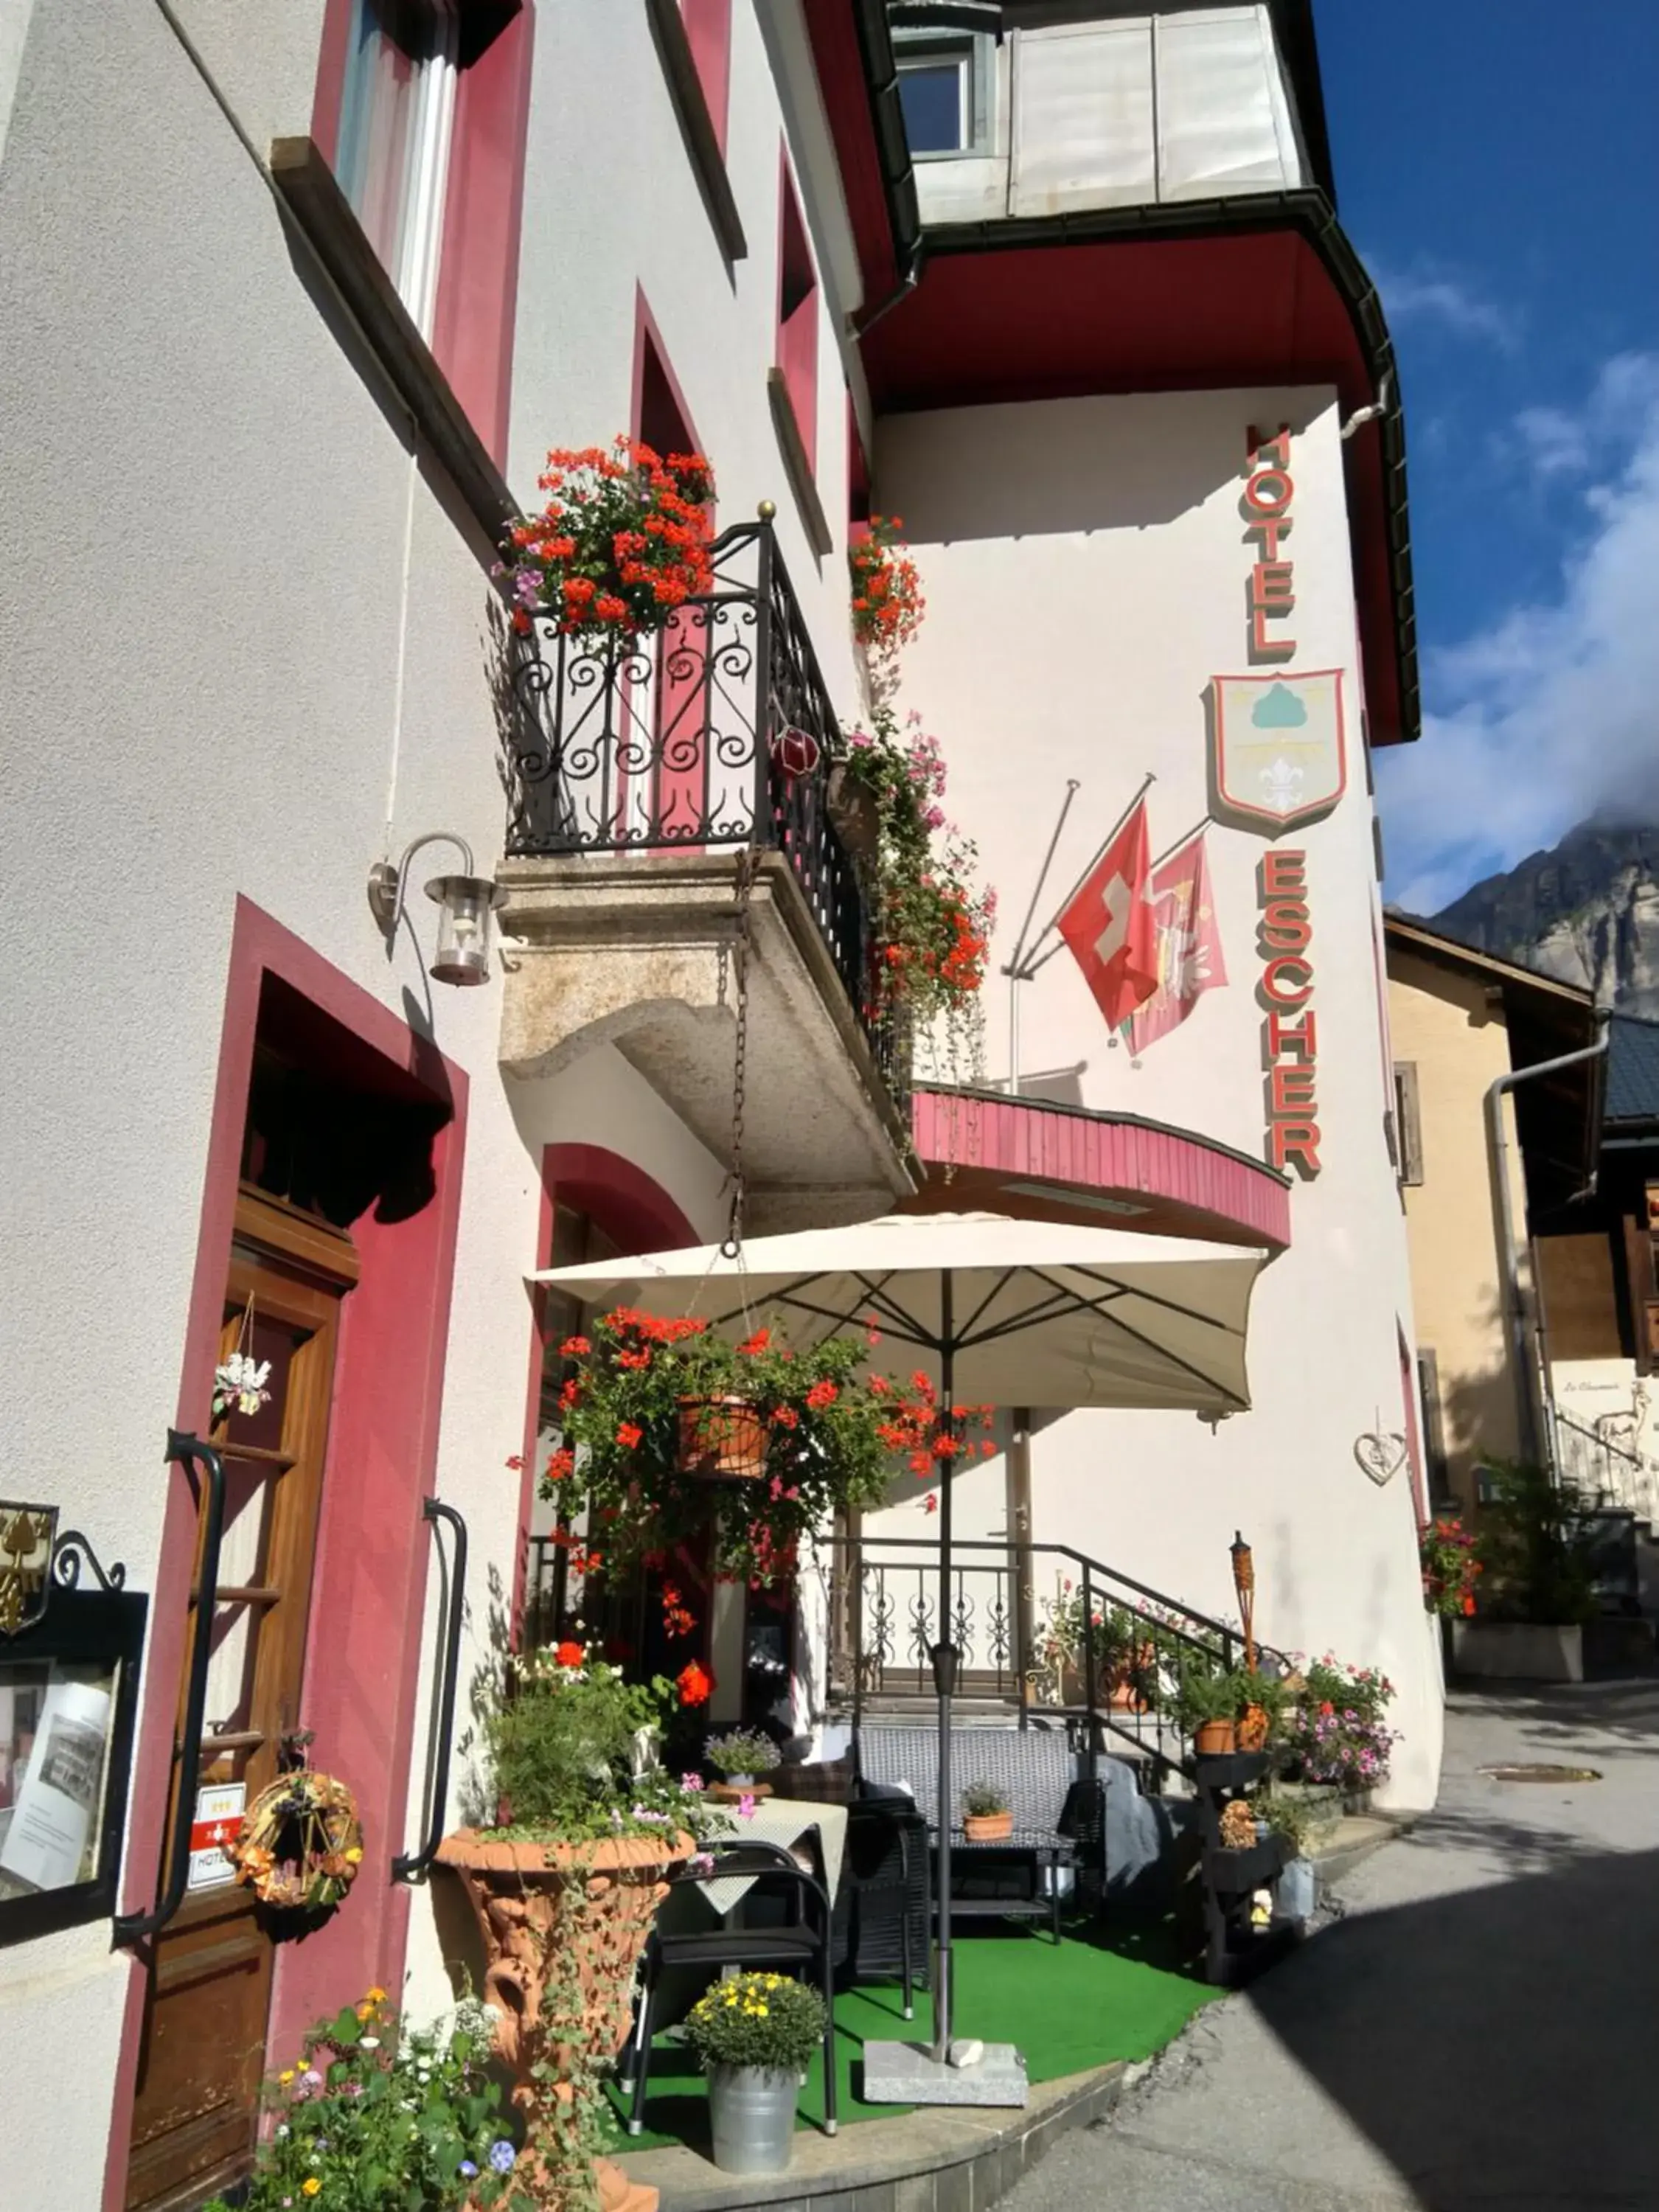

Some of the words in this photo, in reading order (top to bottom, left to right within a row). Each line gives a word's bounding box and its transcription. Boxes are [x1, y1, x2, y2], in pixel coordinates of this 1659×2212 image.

[1245, 422, 1297, 650] HOTEL
[1262, 849, 1321, 1170] ESCHER
[198, 1852, 225, 1868] HOTE
